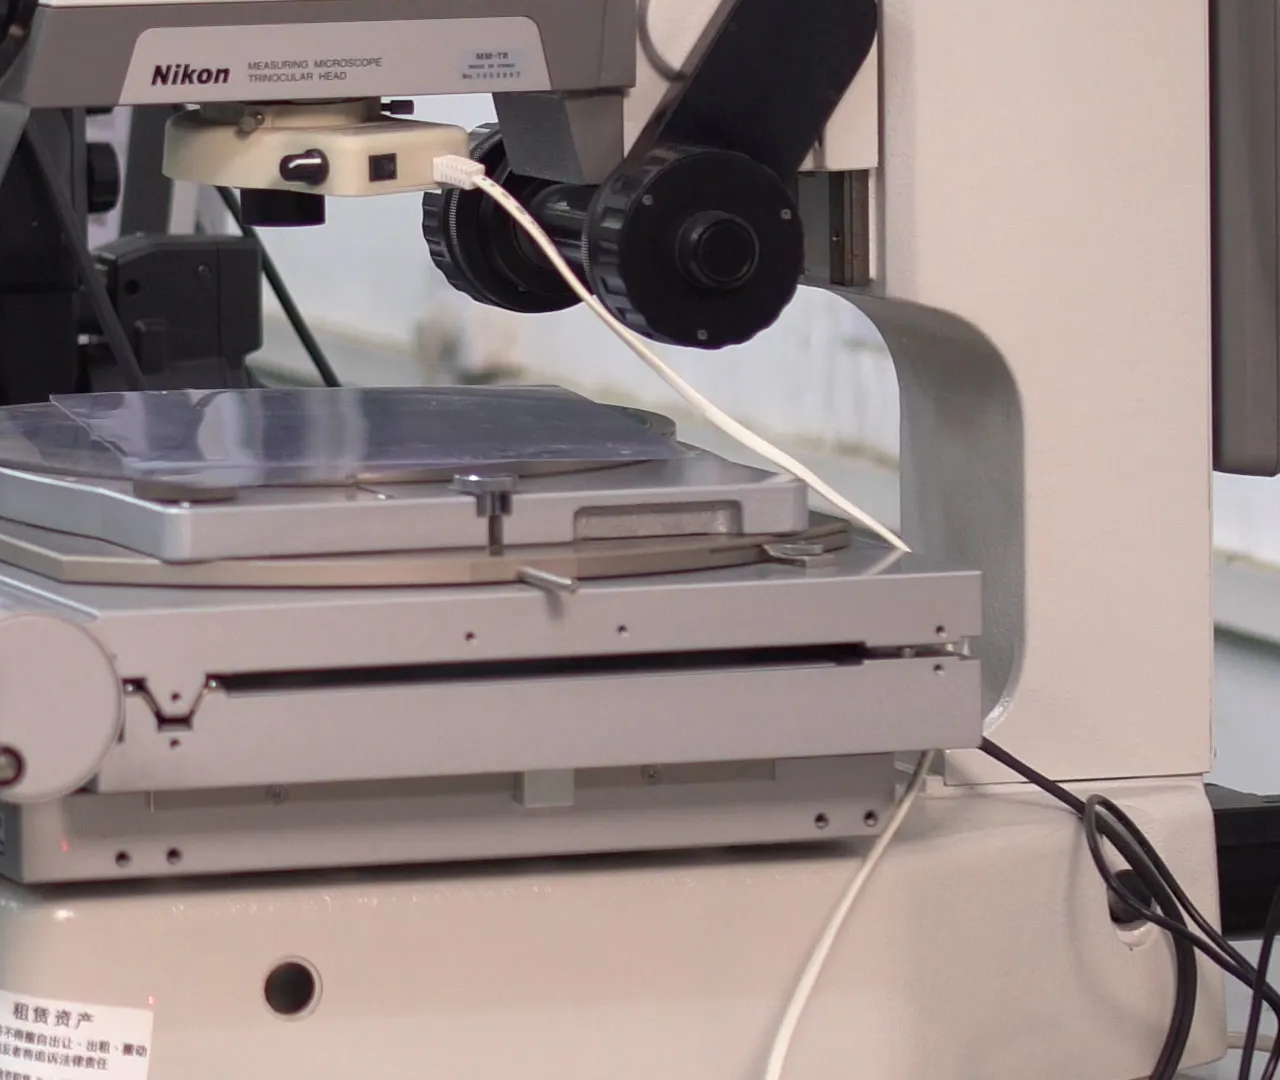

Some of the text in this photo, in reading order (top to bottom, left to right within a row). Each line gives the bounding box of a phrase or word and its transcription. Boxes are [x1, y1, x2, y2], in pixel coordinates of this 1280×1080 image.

[247, 58, 383, 71] MEASURING MICROSCOPE
[151, 64, 230, 86] Nikon
[247, 71, 347, 83] TRINOCULAR HEAD
[13, 1002, 95, 1030] 租赁资产
